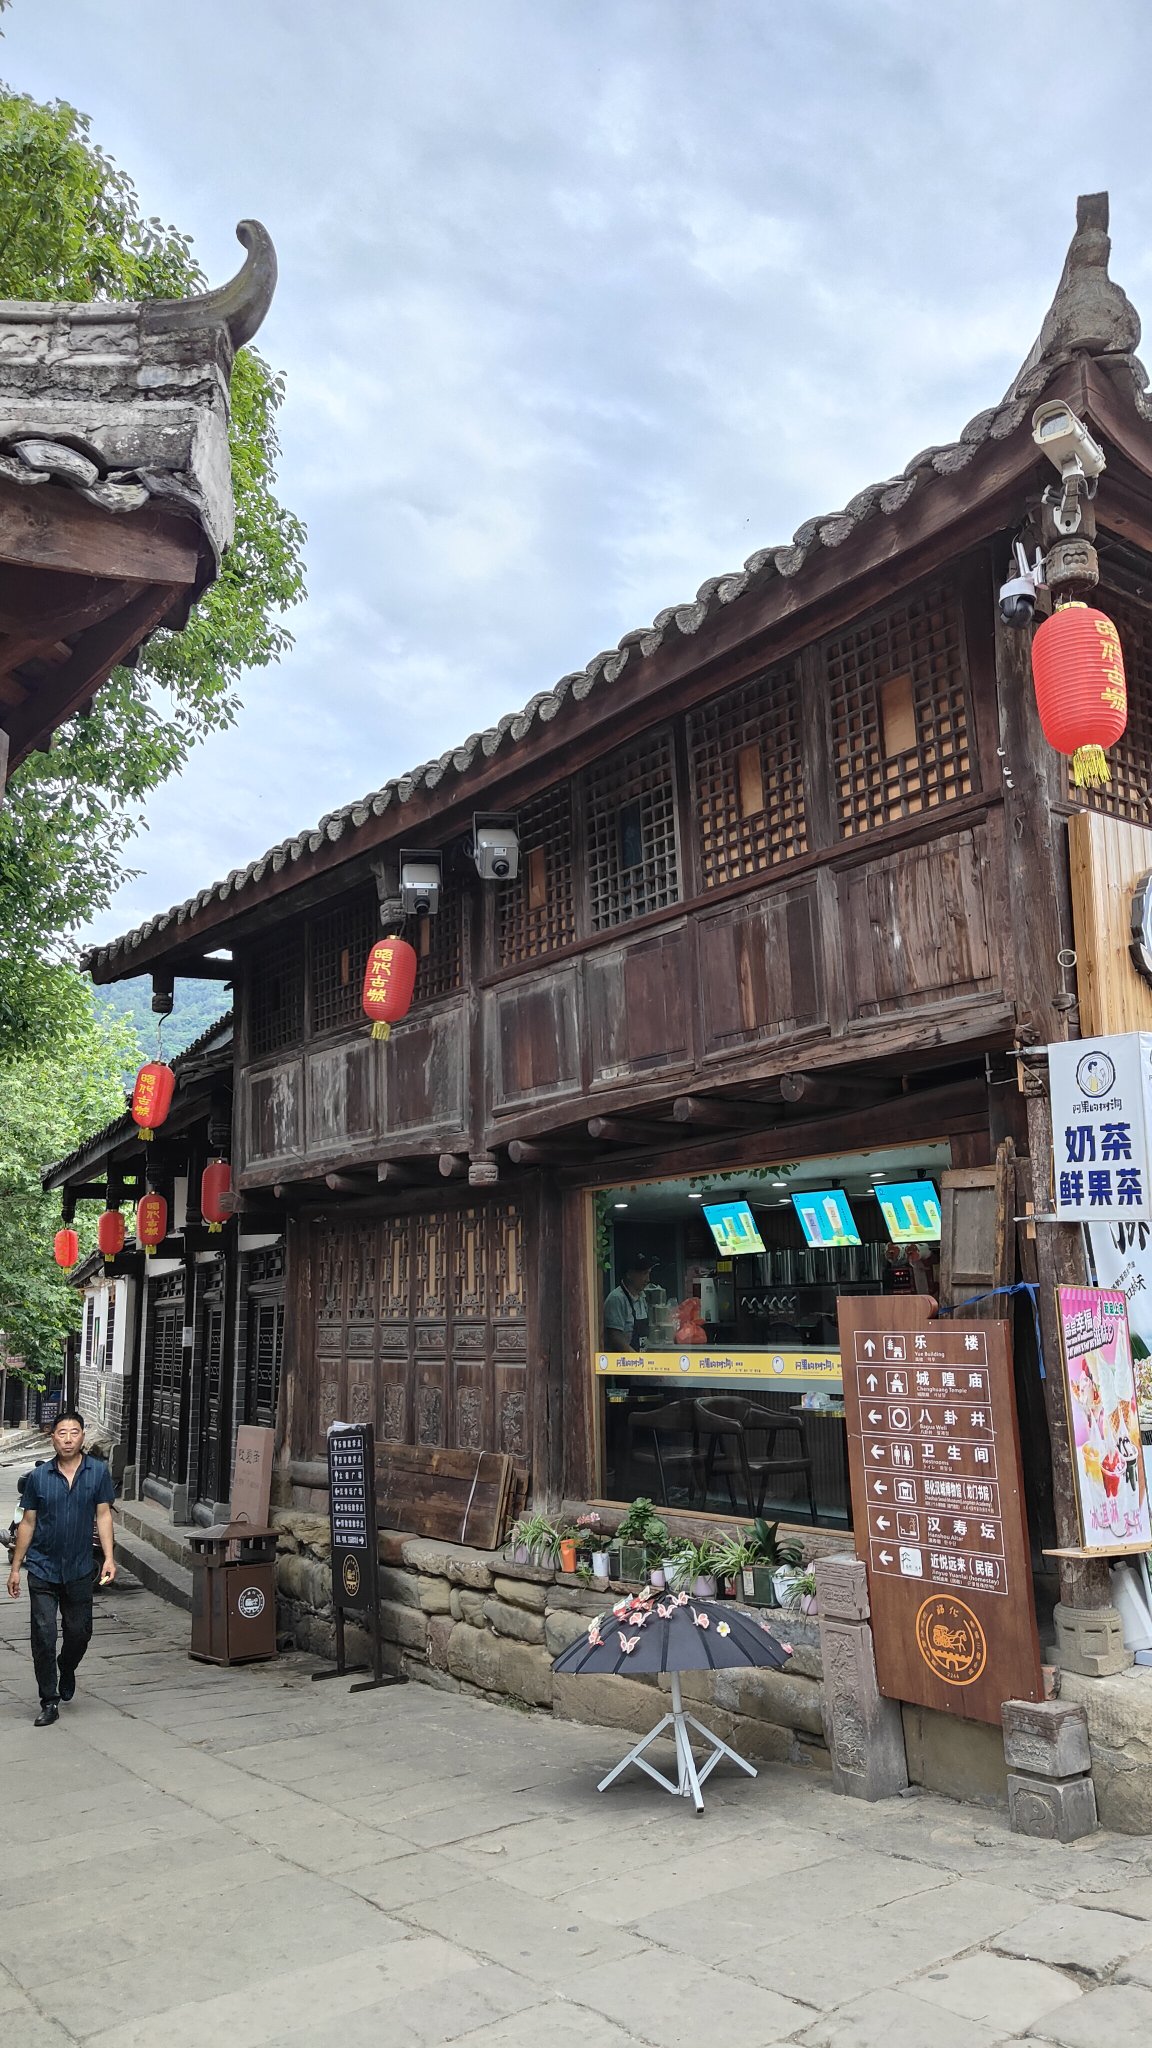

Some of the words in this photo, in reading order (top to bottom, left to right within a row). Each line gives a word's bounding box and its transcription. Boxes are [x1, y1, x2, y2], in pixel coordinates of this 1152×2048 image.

[1064, 1121, 1133, 1163] 奶茶
[1060, 1168, 1143, 1207] 鲜果茶
[914, 1334, 980, 1352] 乐楼
[916, 1370, 983, 1389] 城隍庙
[919, 1409, 986, 1427] 八卦井
[921, 1443, 989, 1463] 卫生间
[927, 1516, 997, 1540] 汉寿坛
